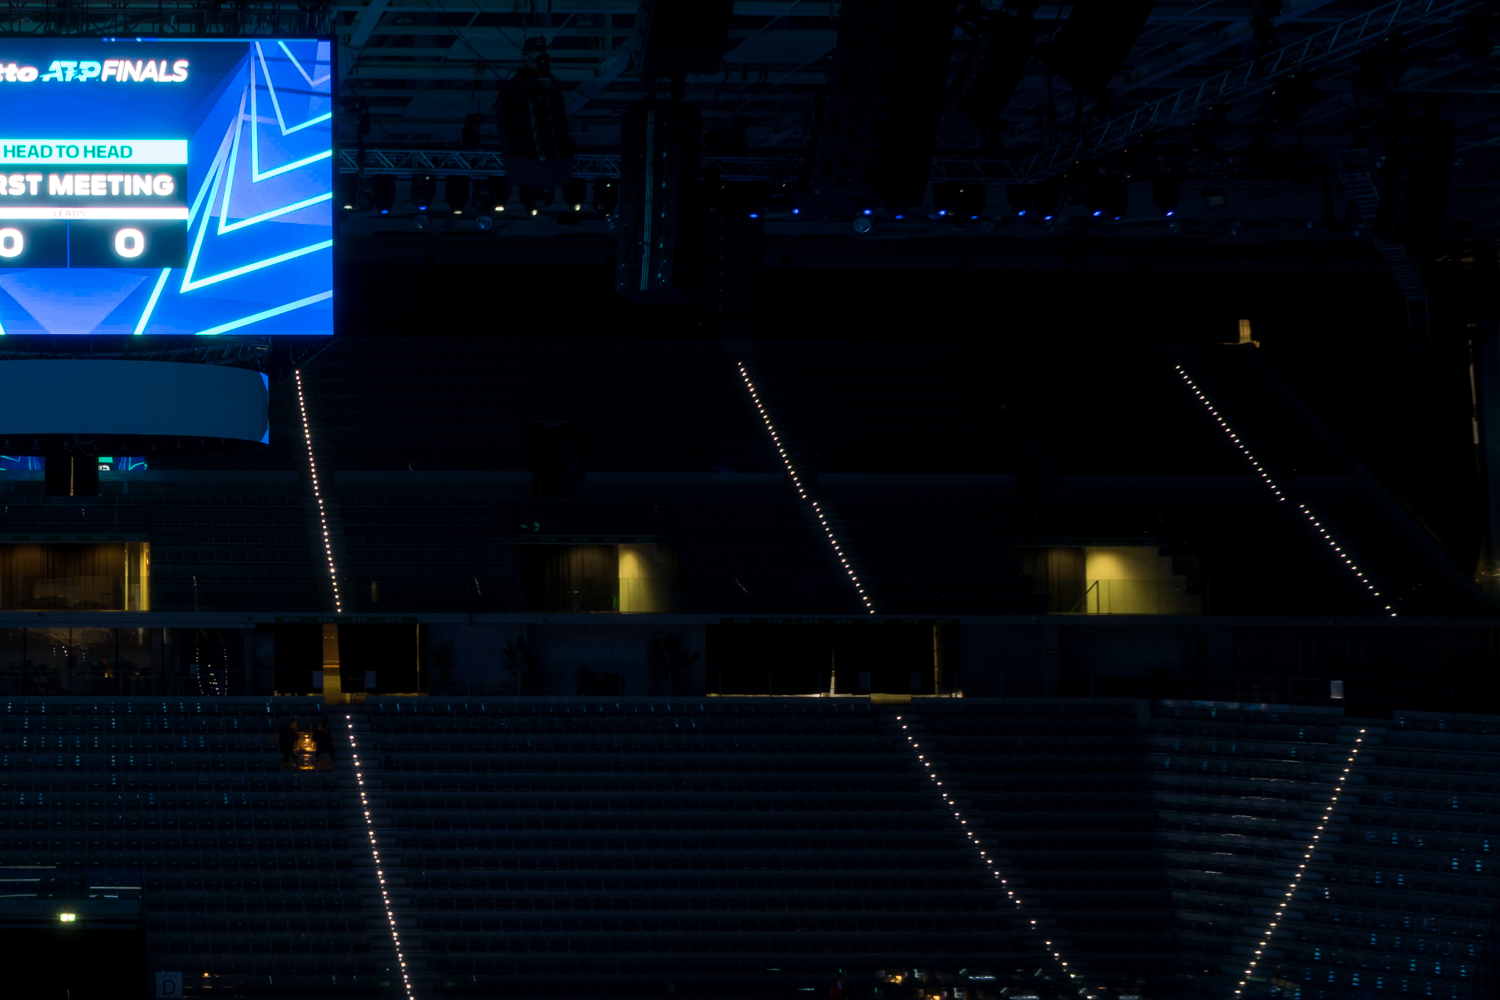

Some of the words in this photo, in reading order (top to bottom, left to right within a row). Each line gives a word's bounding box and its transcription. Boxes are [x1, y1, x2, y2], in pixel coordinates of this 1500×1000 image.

[40, 60, 101, 82] ATP
[101, 59, 190, 82] FINALS
[3, 144, 53, 159] HEAD
[56, 144, 80, 159] TO
[83, 144, 133, 159] HEAD
[48, 173, 175, 197] MEETING
[114, 226, 145, 258] 0
[163, 979, 176, 995] D
